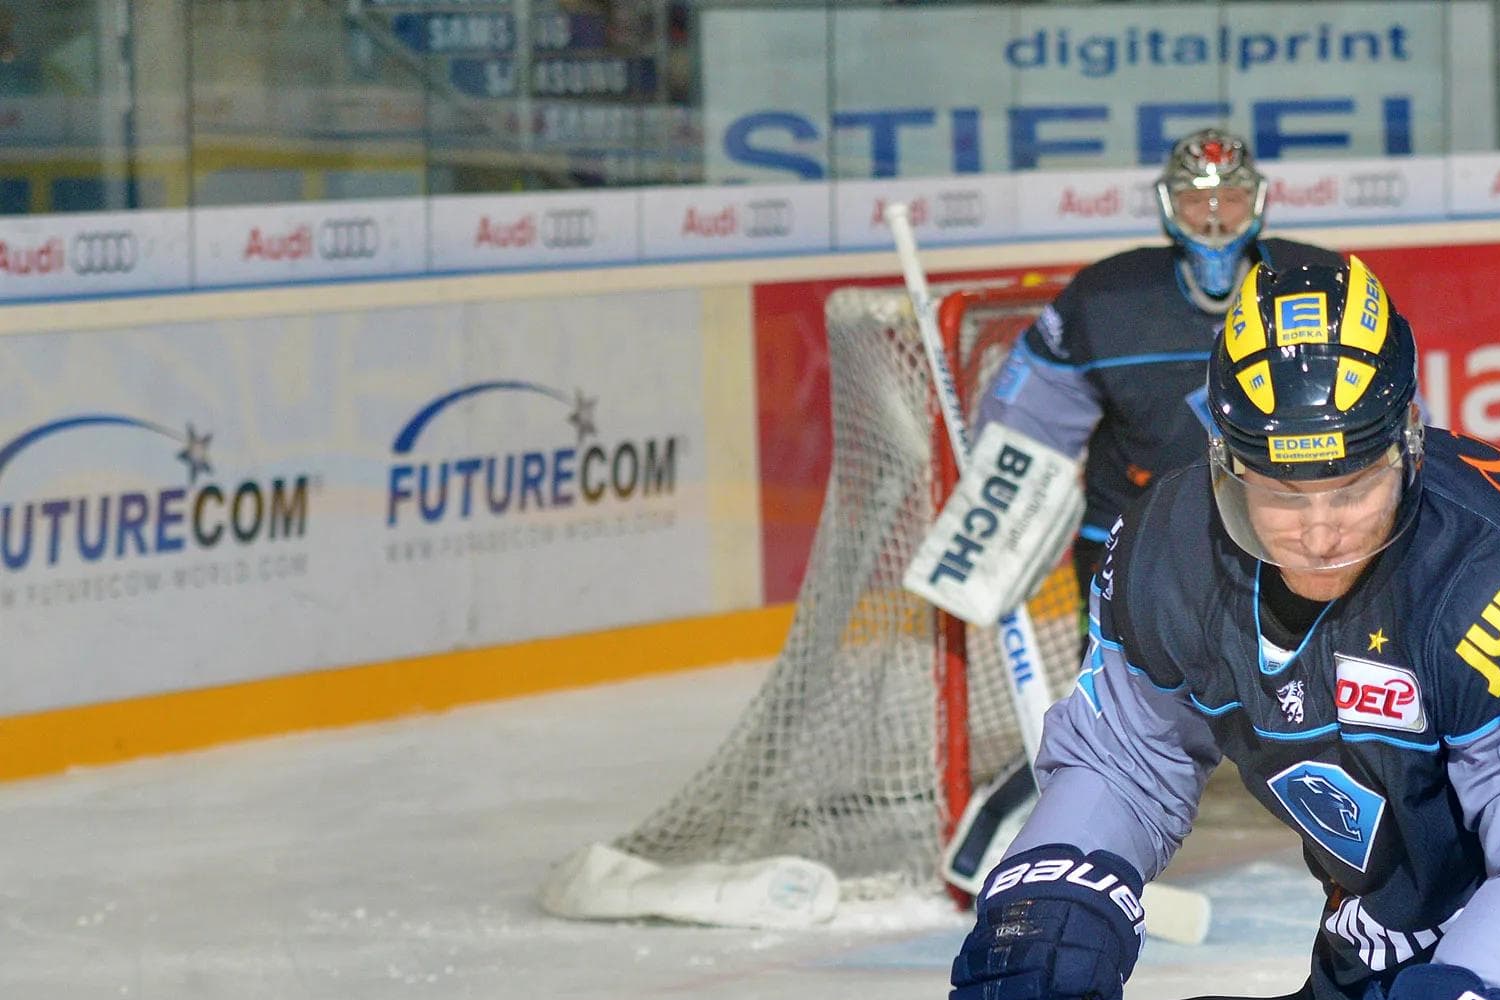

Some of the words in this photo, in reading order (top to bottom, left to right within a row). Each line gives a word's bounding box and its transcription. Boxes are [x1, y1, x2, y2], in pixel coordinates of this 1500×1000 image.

[1004, 23, 1409, 77] digitalprint
[1059, 186, 1123, 219] Audi
[1269, 176, 1338, 209] Audi
[244, 218, 312, 261] Audi
[475, 214, 537, 249] Audi
[682, 206, 737, 239] Audi
[0, 238, 64, 276] Audi
[1281, 297, 1321, 331] E
[1282, 330, 1323, 341] EDEKA
[1274, 436, 1338, 451] EDEKA
[386, 436, 677, 527] FUTURECOM
[0, 477, 310, 570] UTURECOM
[1335, 678, 1412, 720] DEL
